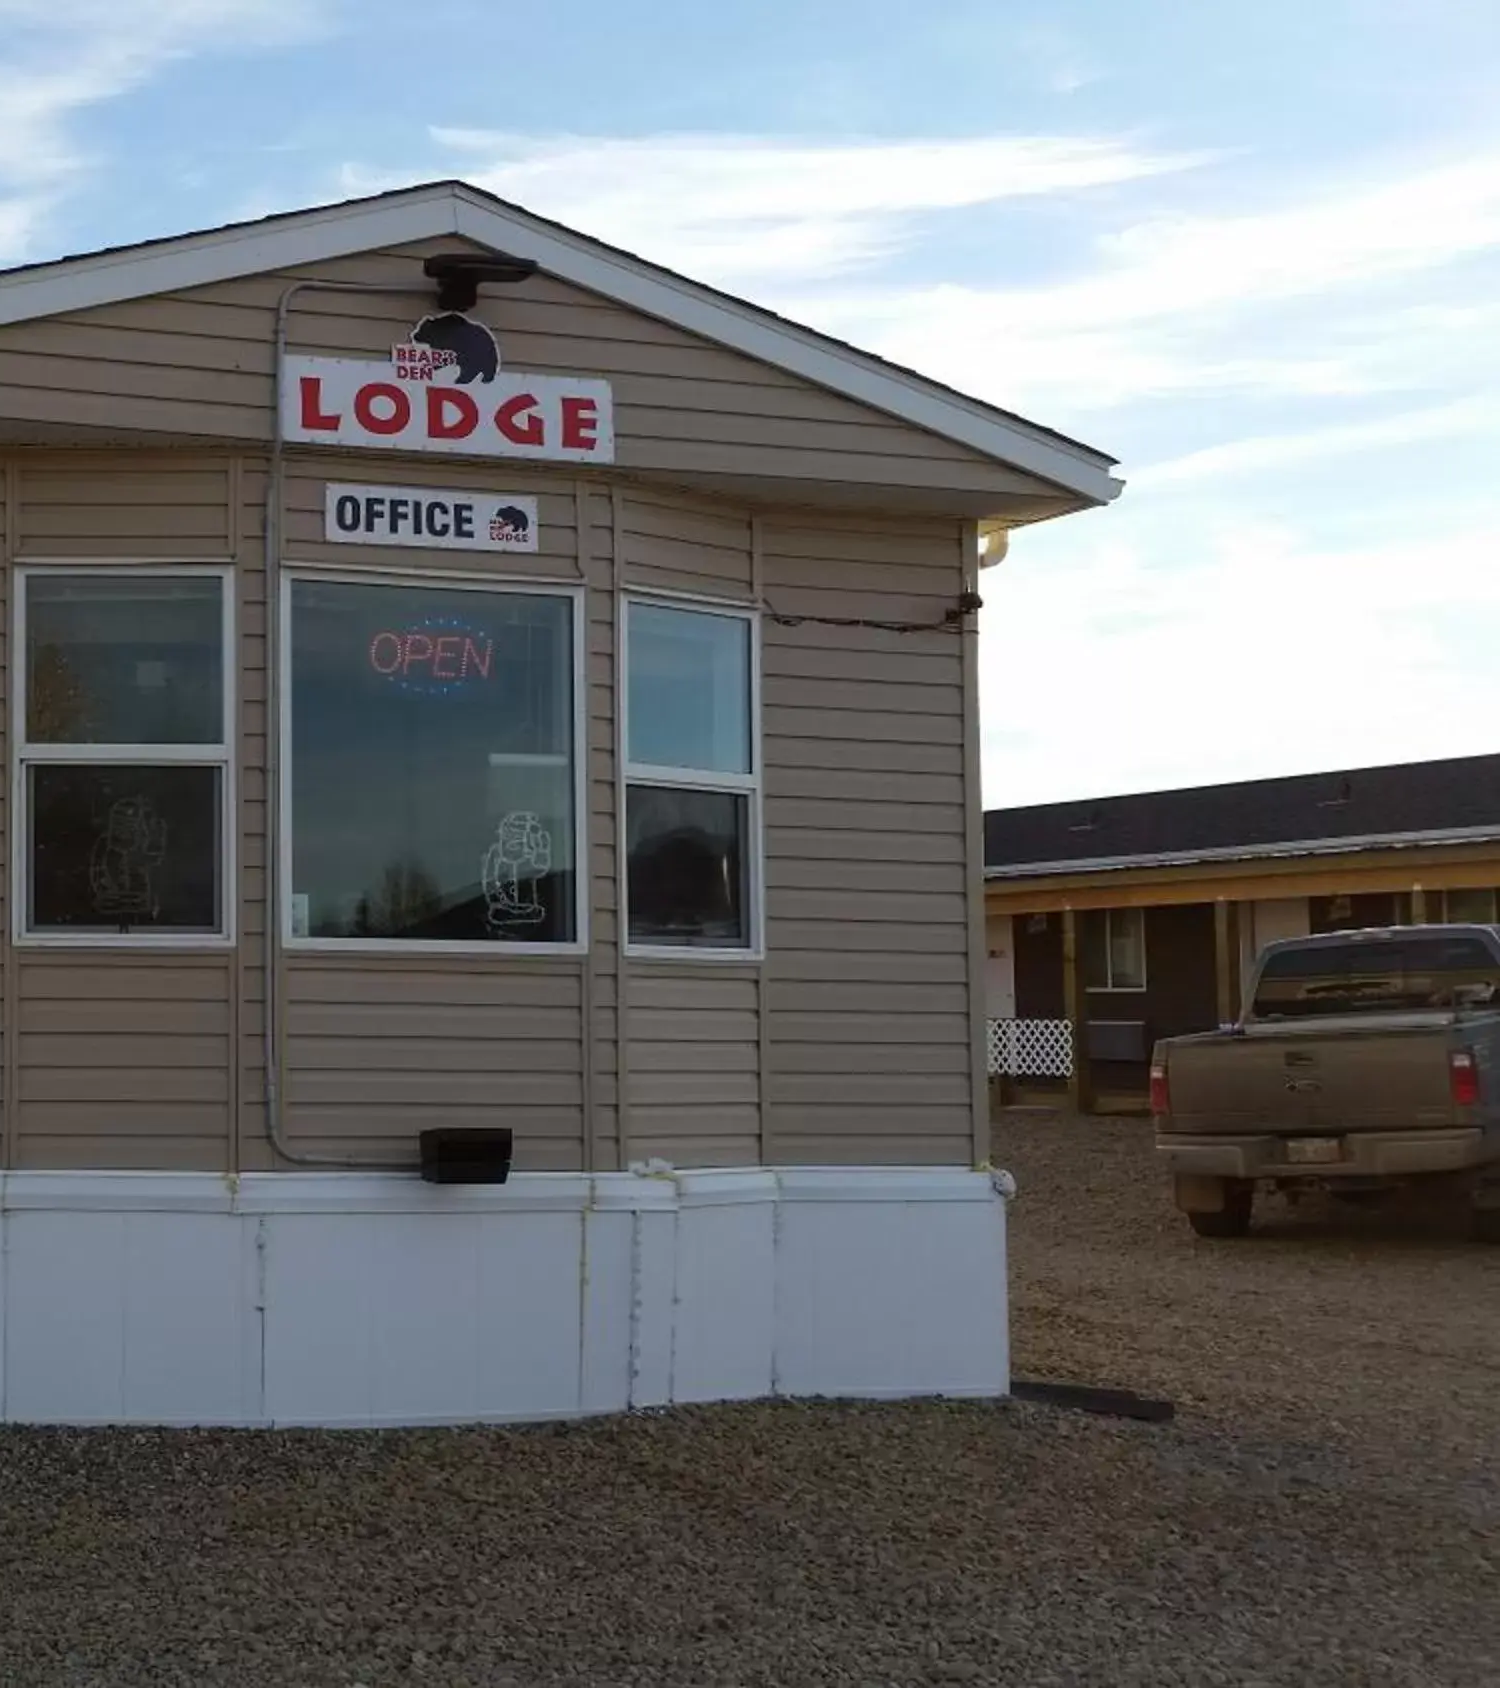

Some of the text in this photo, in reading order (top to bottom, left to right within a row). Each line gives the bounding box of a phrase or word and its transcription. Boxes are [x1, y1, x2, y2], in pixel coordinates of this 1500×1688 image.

[396, 365, 433, 381] DEN
[300, 377, 597, 450] LODGE
[336, 495, 475, 539] OFFICE
[489, 532, 529, 543] LODGE
[369, 631, 494, 680] OPEN
